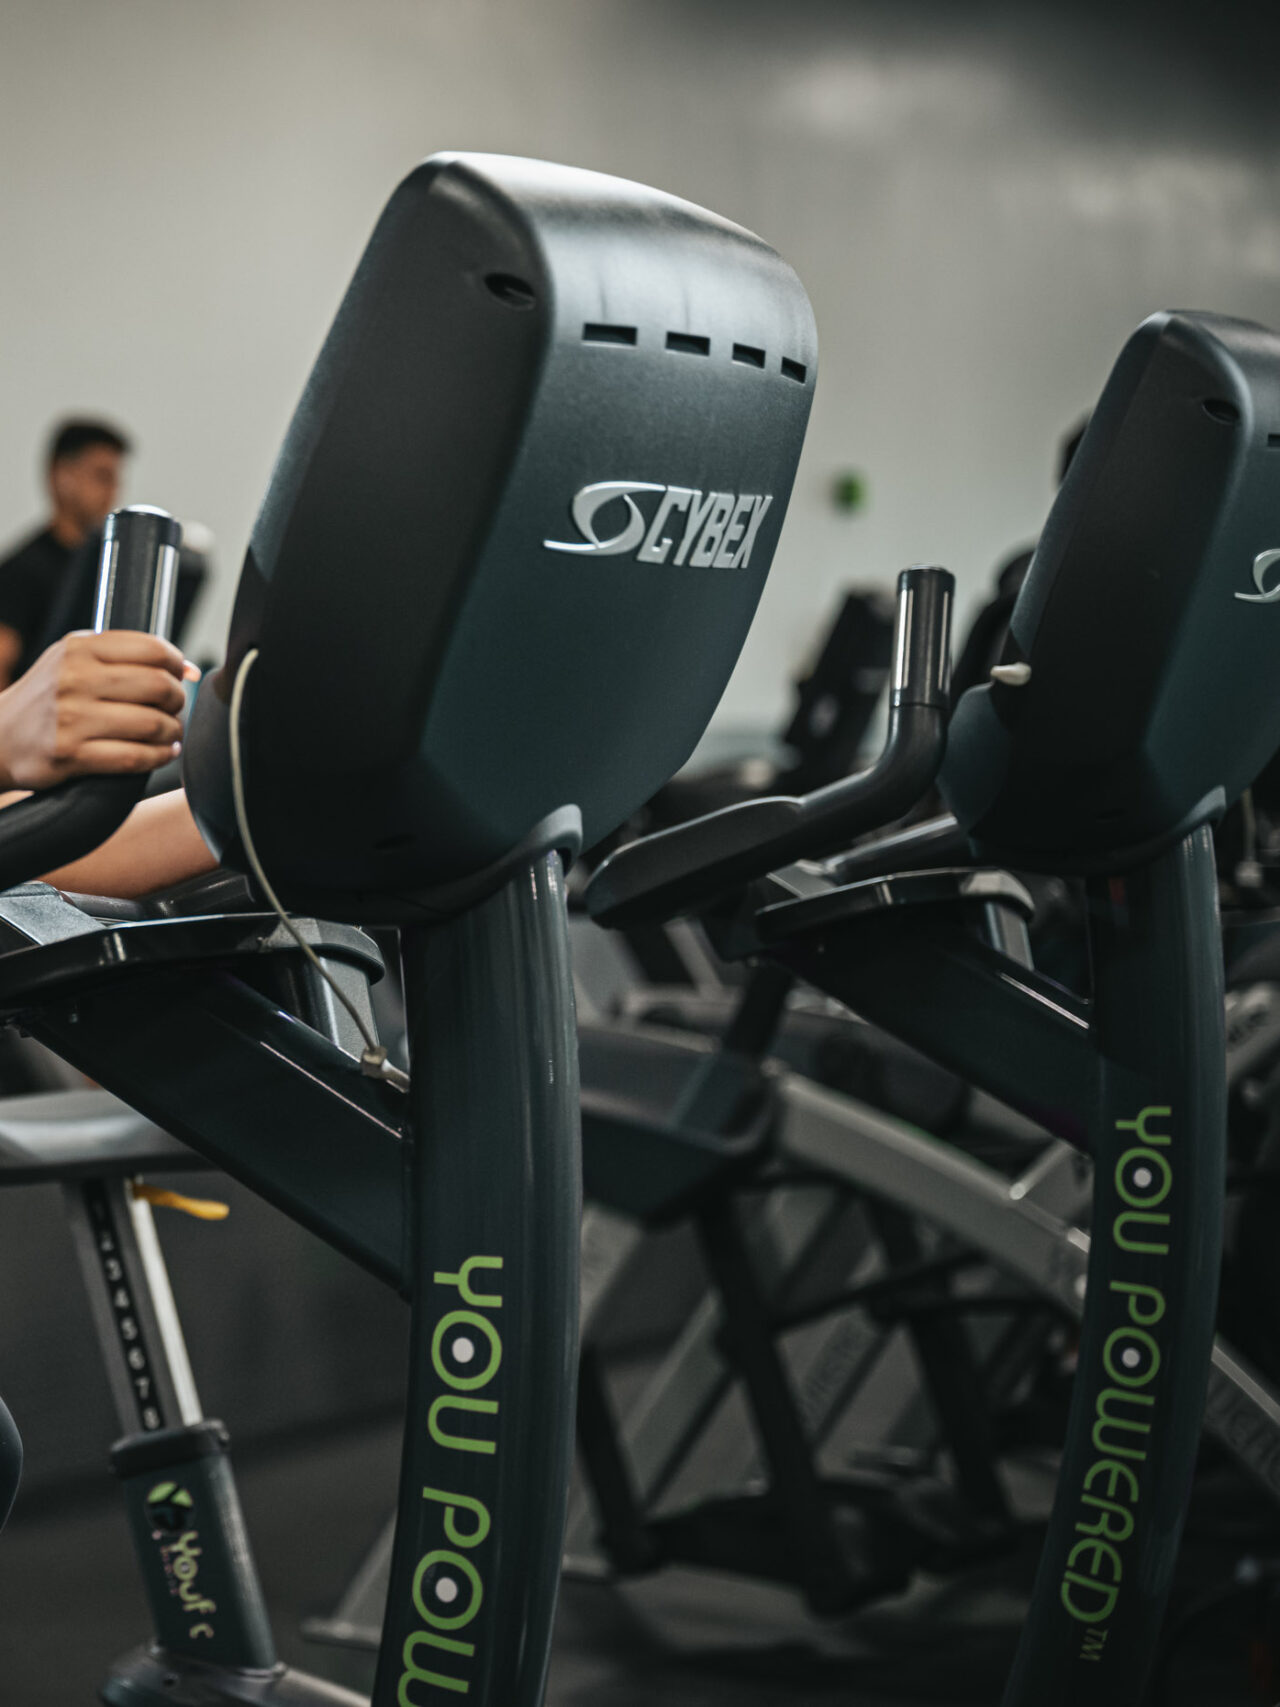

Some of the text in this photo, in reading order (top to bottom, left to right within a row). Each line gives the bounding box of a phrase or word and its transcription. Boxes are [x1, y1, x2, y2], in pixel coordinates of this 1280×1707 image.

[636, 485, 774, 569] CYBEX
[1113, 1106, 1173, 1255] YOU
[135, 1376, 150, 1399] 7
[1060, 1280, 1166, 1623] POWERED
[397, 1256, 503, 1707] YOU POW
